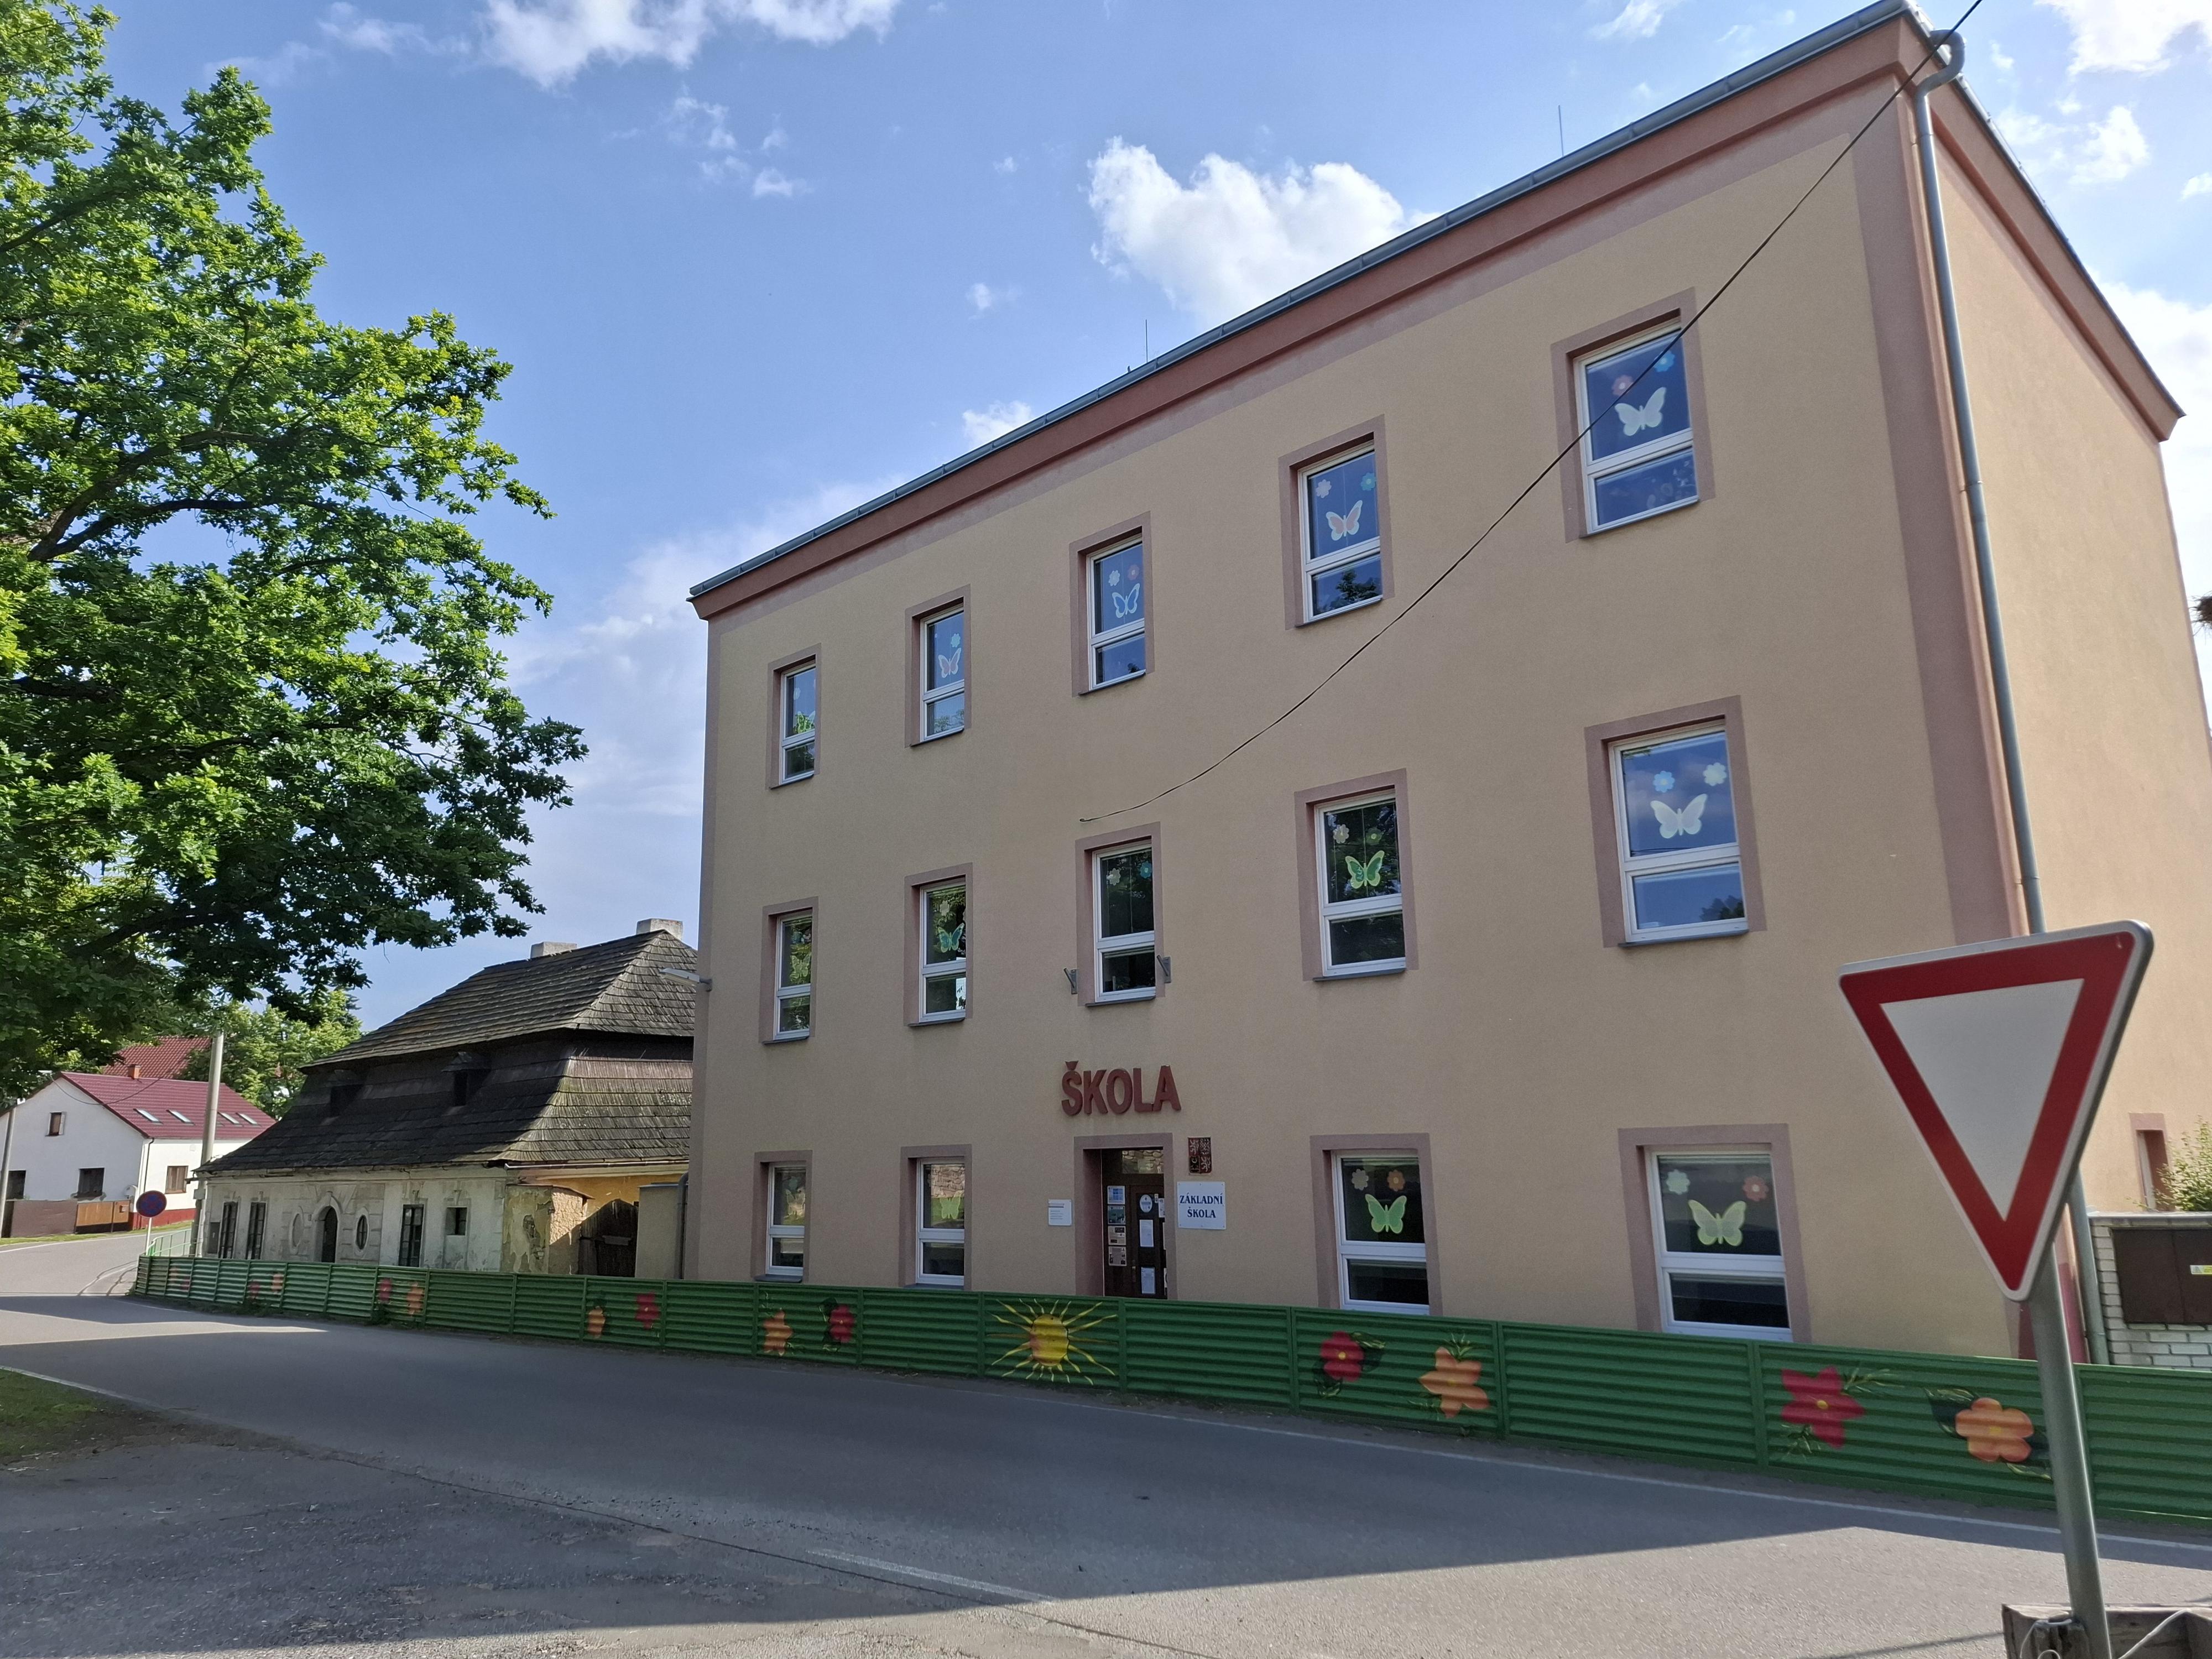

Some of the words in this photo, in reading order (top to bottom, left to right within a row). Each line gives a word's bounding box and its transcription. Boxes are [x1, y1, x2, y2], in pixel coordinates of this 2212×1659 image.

[1061, 1061, 1182, 1116] ŠKOLA
[1180, 1192, 1223, 1204] ZÁKLADNÍ
[1187, 1207, 1216, 1218] ŠKOLA
